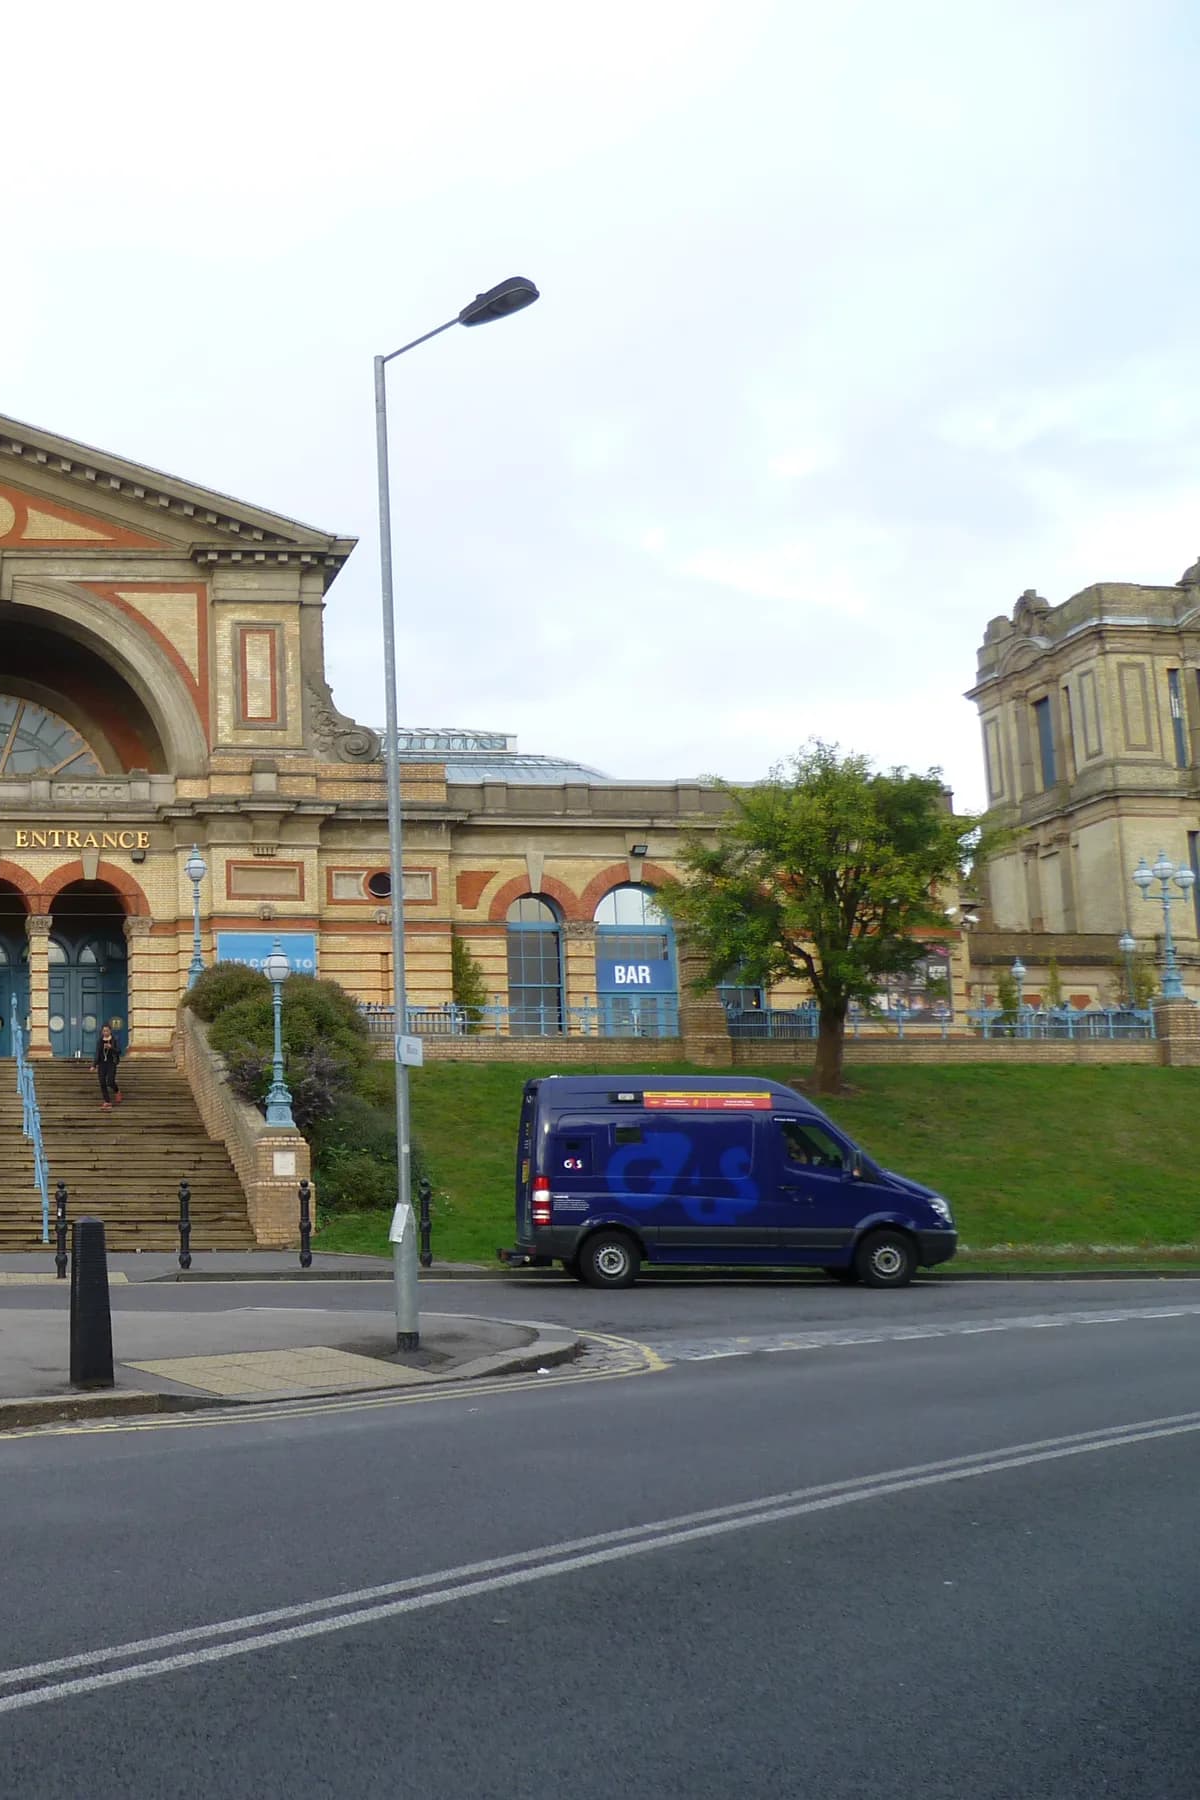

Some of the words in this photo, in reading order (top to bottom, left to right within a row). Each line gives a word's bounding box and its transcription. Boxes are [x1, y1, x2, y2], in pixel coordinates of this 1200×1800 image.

[15, 830, 150, 849] ENTRANCE
[295, 959, 313, 969] TO
[614, 965, 651, 984] BAR
